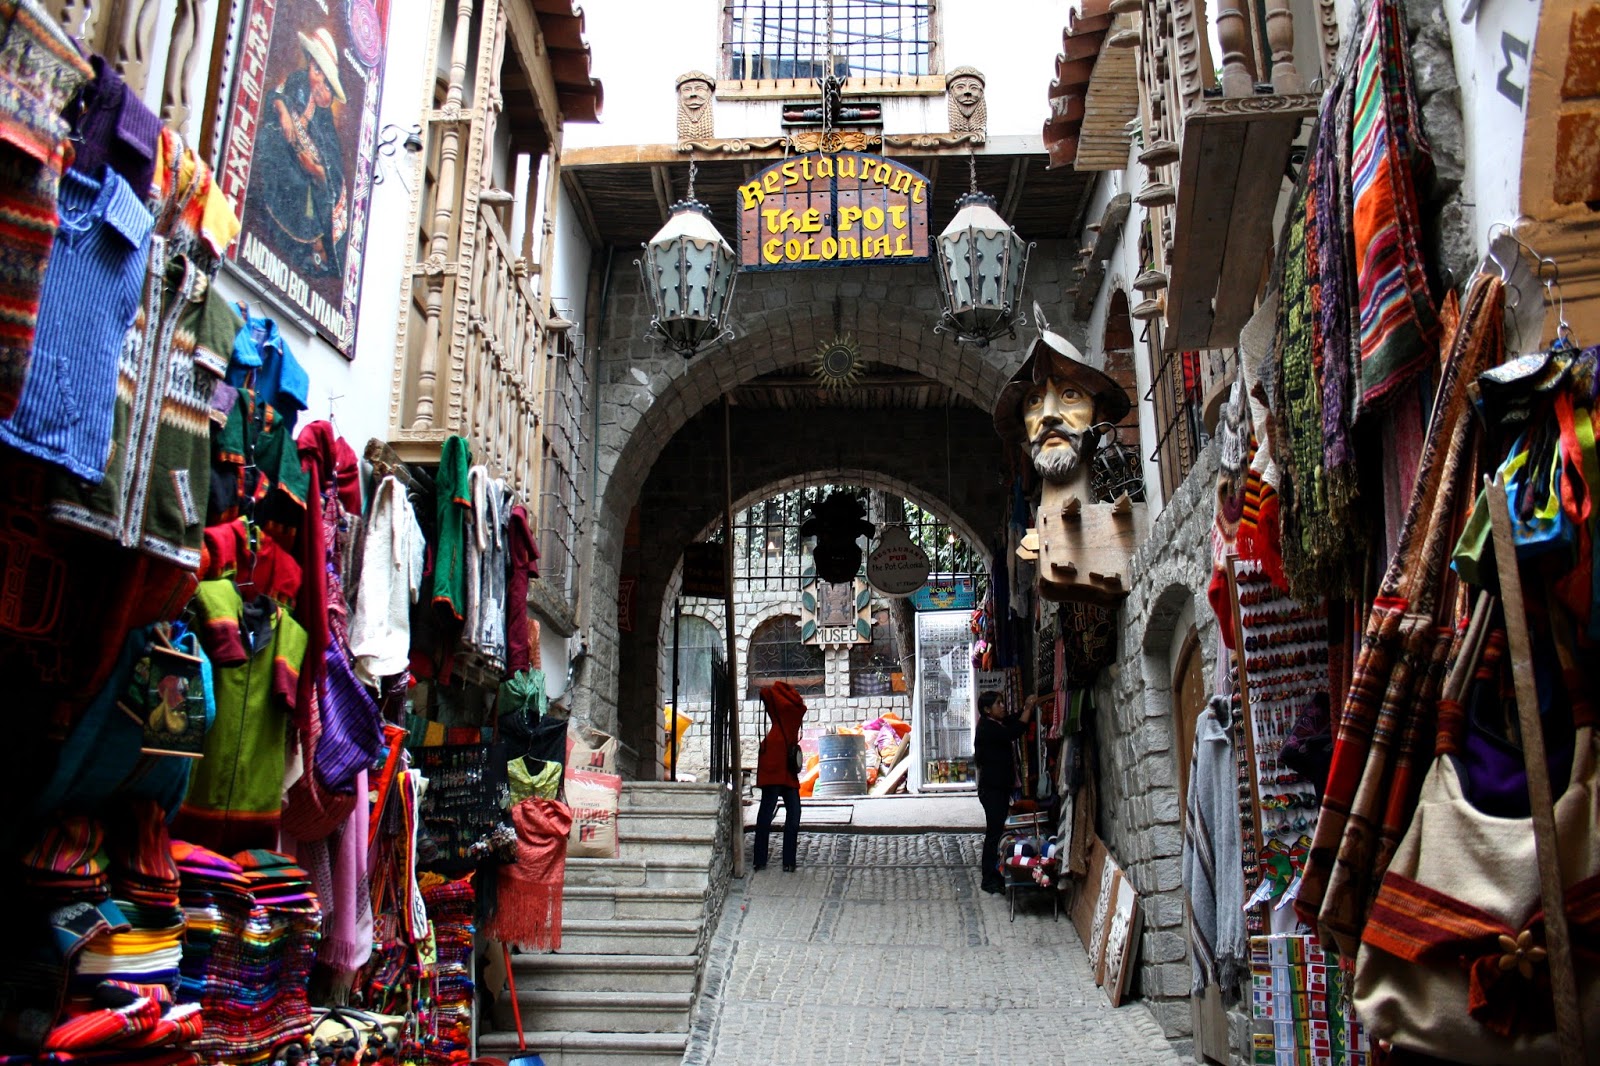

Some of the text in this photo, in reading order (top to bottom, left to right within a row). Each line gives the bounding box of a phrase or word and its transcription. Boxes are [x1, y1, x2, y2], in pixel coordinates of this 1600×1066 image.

[738, 156, 926, 211] Restaurant
[838, 205, 907, 232] POT
[762, 233, 914, 264] COLONIAL
[242, 231, 347, 342] ANDINO BOLIVIANO
[872, 546, 924, 562] RESTAURANT
[815, 628, 859, 643] MUSEO
